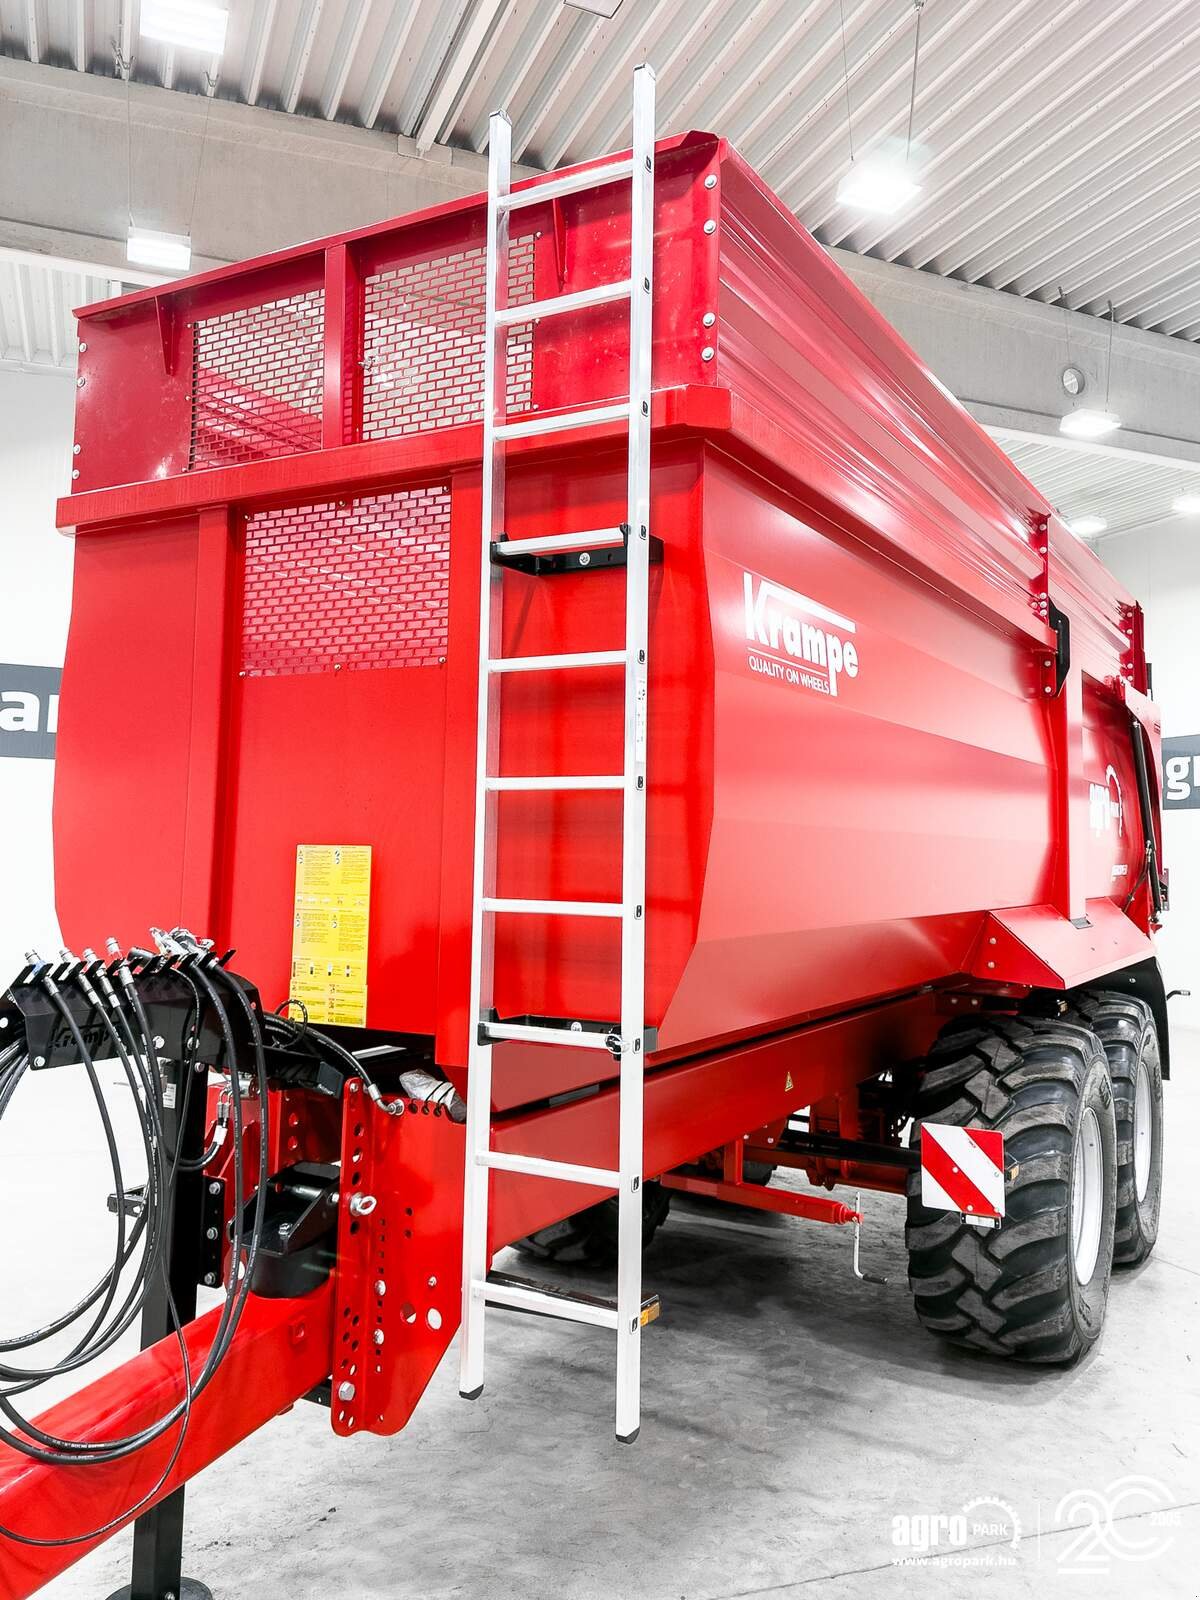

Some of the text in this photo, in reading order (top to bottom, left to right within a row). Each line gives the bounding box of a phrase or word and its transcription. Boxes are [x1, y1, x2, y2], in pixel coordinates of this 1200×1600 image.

[743, 571, 859, 697] Krampe
[748, 655, 830, 695] QUALITY ON WHEELS
